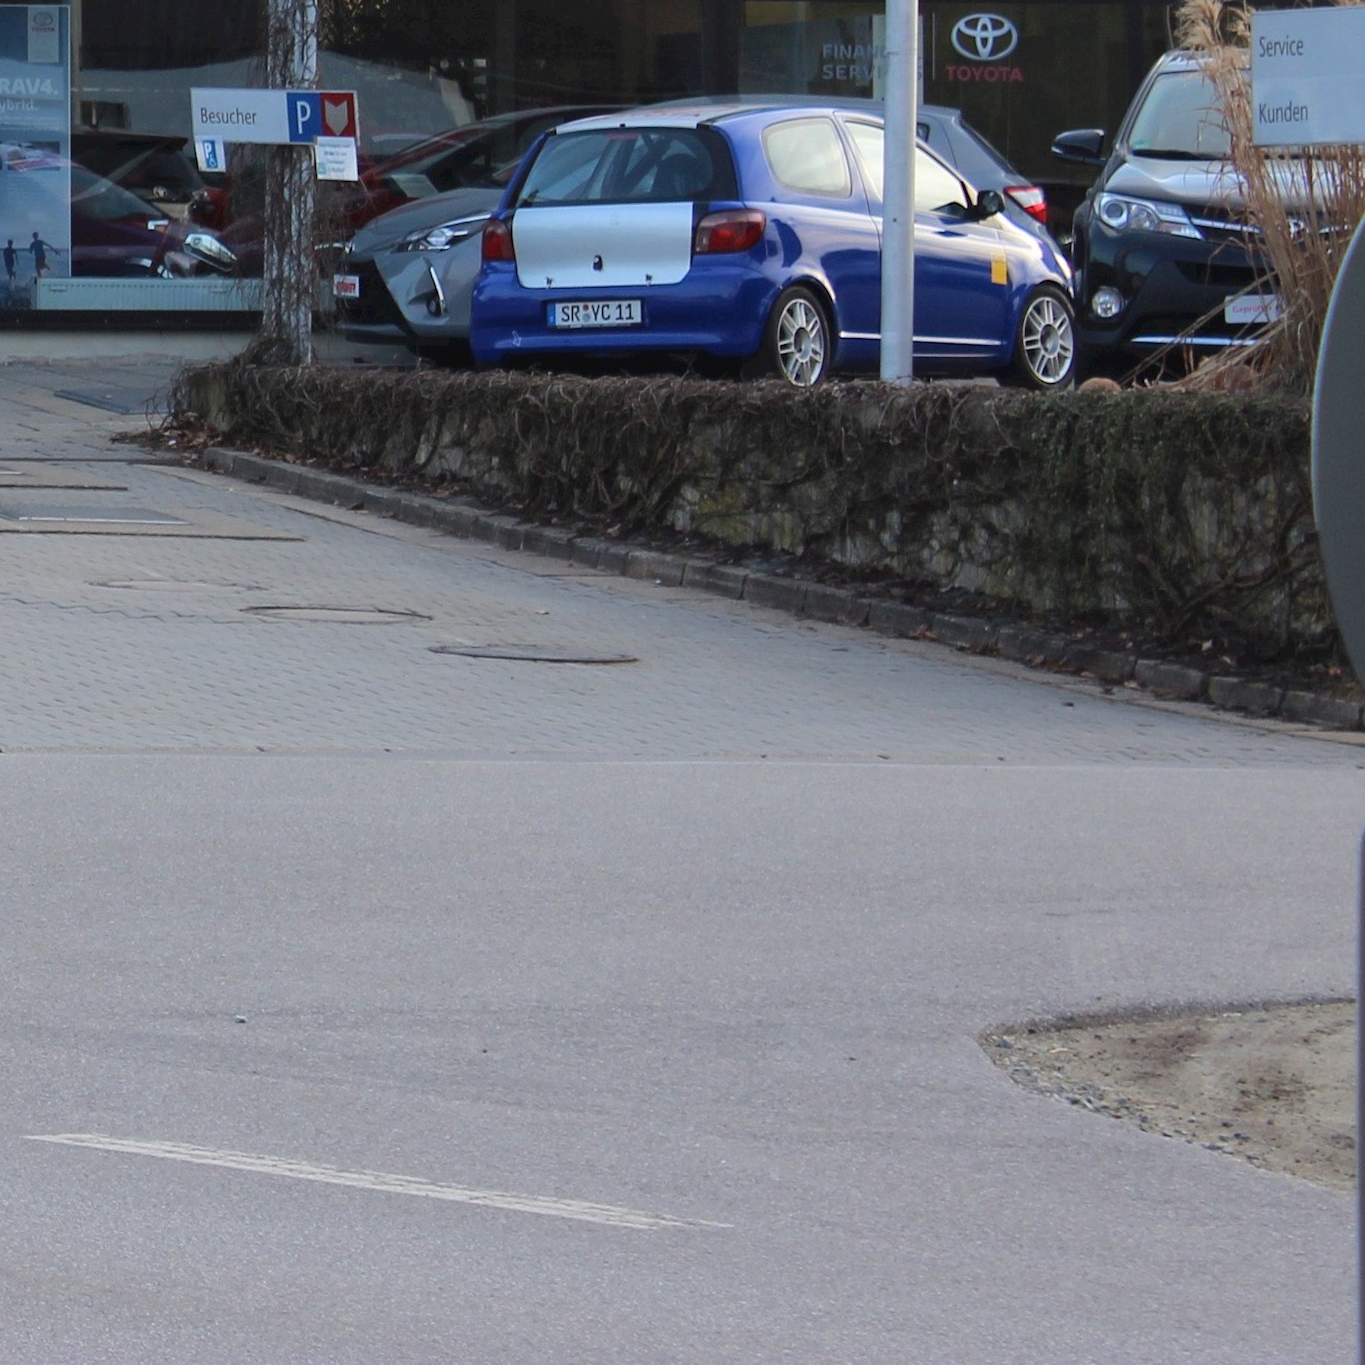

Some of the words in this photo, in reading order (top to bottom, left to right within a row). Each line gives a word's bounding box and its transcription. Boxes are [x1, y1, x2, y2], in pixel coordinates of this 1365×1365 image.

[1259, 35, 1304, 57] Service
[945, 65, 1024, 82] TOYOTA
[200, 107, 257, 125] Besucher
[296, 100, 312, 135] P
[1259, 101, 1309, 124] Kunden
[561, 307, 580, 322] SR
[591, 305, 610, 320] YC
[616, 304, 633, 320] 11
